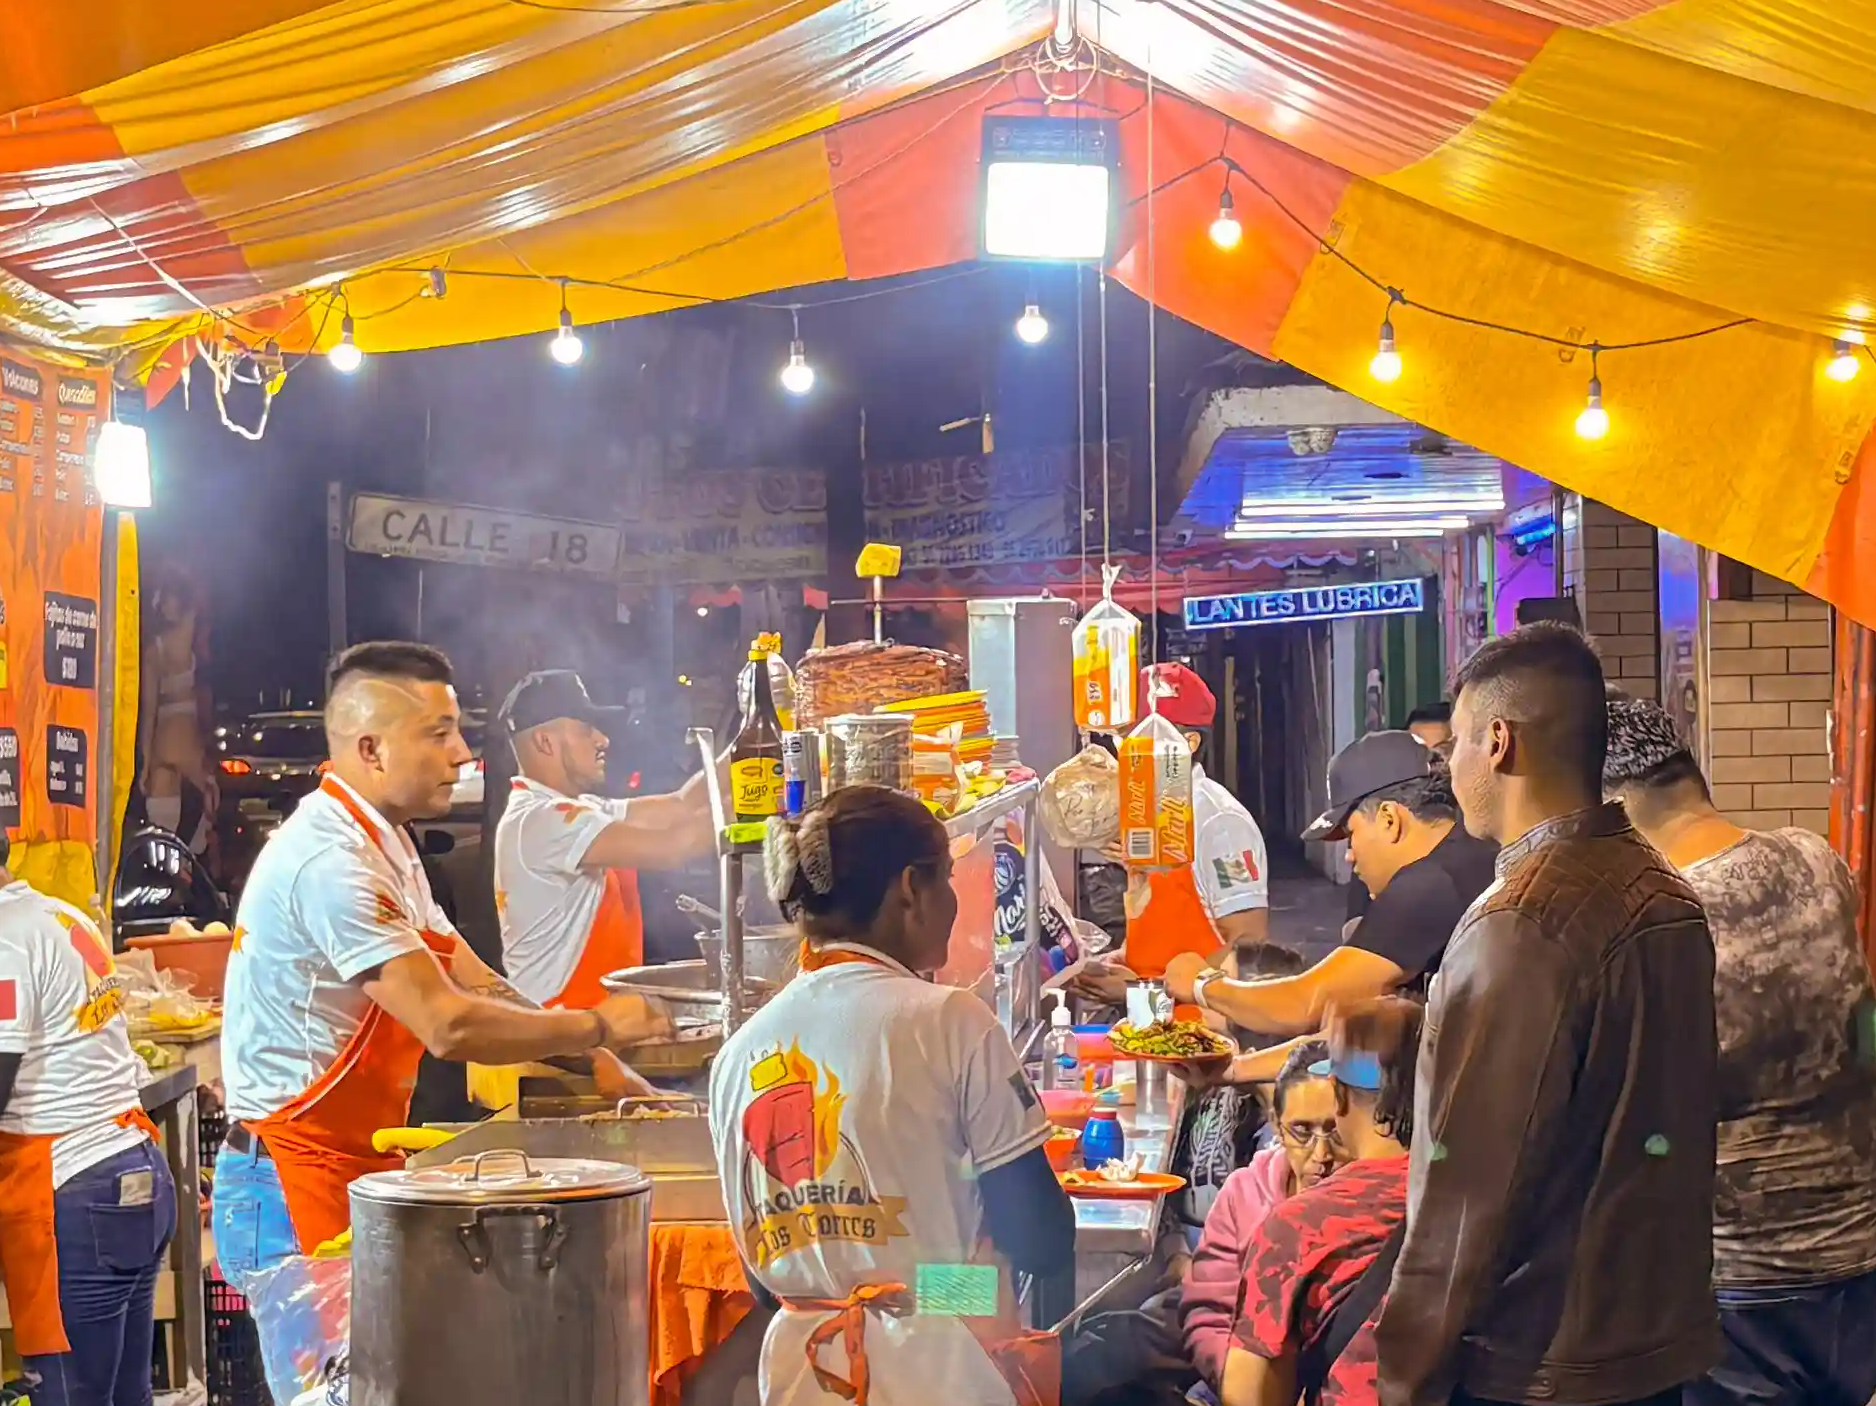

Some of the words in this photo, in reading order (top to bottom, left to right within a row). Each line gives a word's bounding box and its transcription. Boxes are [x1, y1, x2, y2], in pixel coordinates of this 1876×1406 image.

[381, 509, 513, 554] CALLE
[547, 530, 588, 565] 18
[739, 782, 769, 801] Jugo
